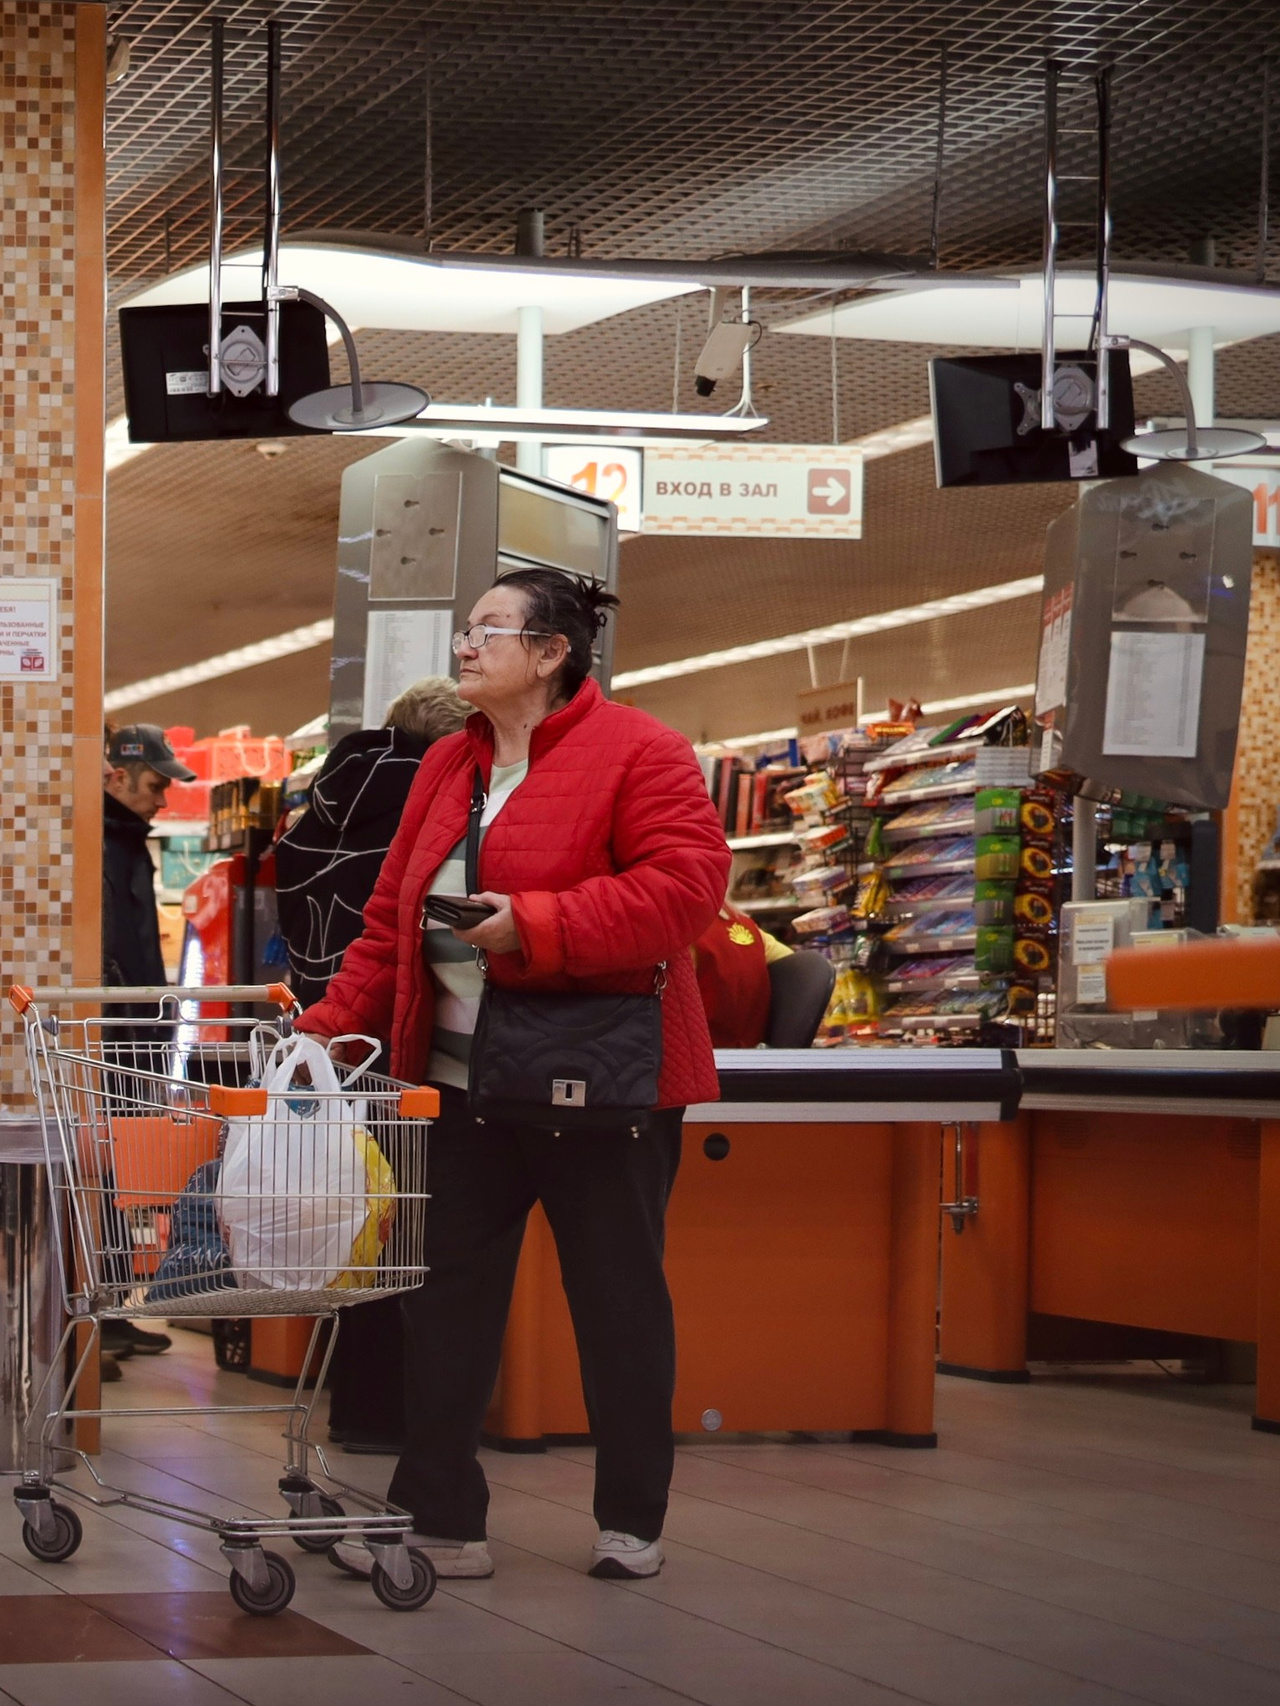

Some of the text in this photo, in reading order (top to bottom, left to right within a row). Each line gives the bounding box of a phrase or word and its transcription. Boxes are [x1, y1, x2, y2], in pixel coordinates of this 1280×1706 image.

[655, 481, 778, 499] ВХОД В ЗАЛ
